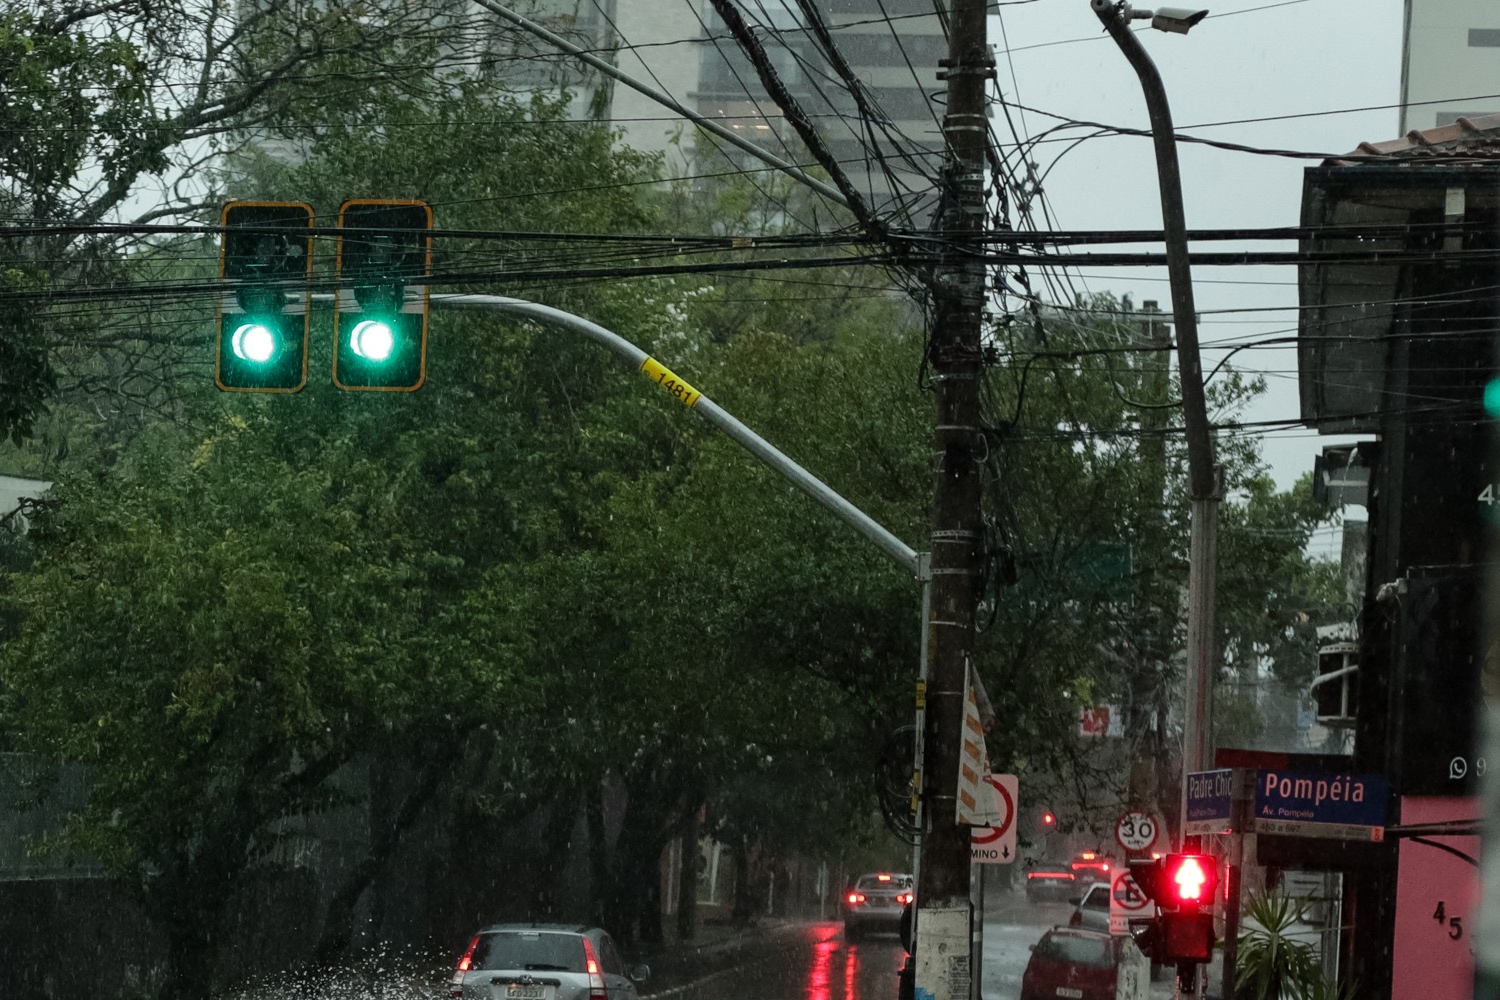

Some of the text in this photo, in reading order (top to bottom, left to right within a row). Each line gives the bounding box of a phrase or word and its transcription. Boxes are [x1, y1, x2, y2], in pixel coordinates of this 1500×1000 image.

[659, 373, 692, 403] 1481
[1189, 774, 1213, 799] Padre
[1265, 773, 1364, 806] Pompéia
[1122, 819, 1152, 838] 30
